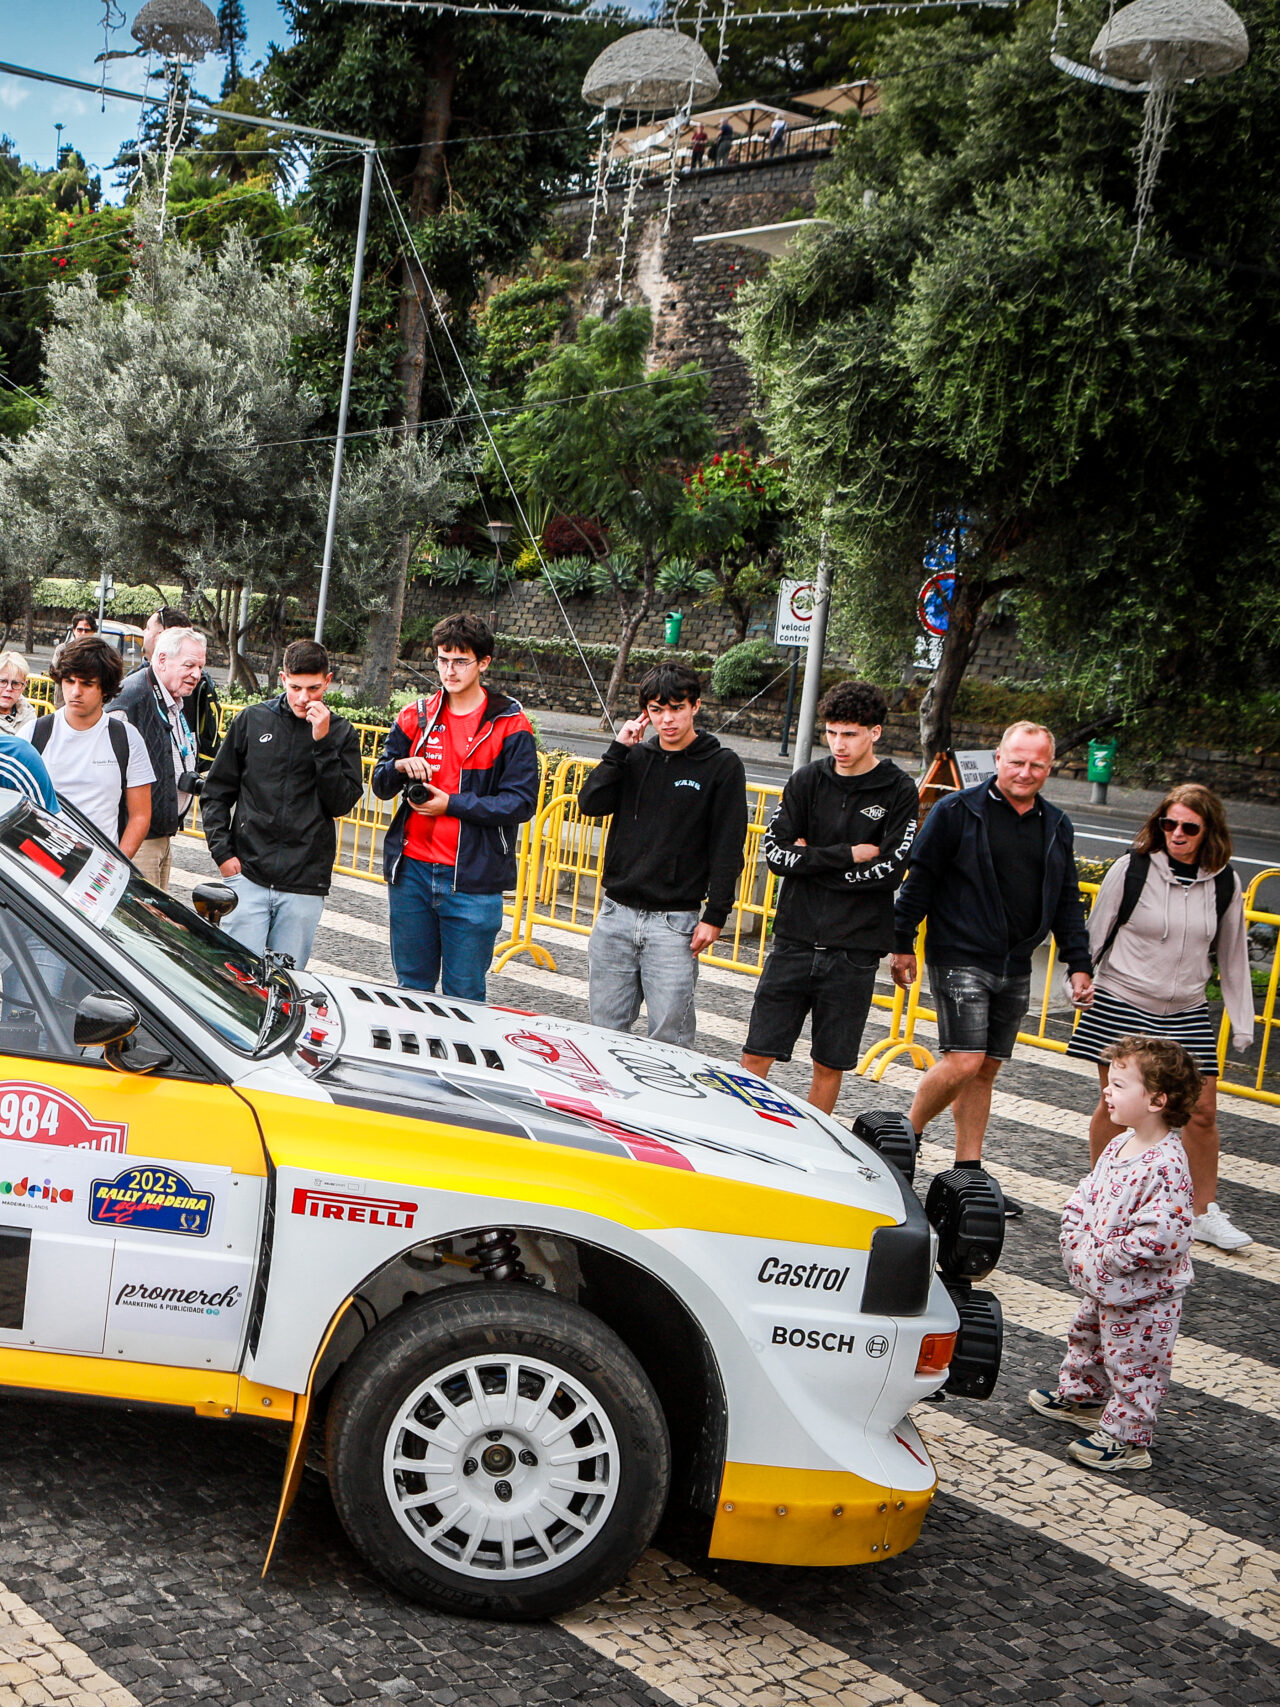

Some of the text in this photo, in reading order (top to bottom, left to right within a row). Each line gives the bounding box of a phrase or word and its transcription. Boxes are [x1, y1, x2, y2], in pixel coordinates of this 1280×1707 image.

[781, 623, 811, 632] velocid
[673, 779, 701, 791] VANS
[128, 1171, 178, 1193] 2025
[95, 1186, 208, 1211] RALLY MADEIRA
[291, 1187, 419, 1229] PIRELLI
[757, 1256, 851, 1292] Castrol
[115, 1283, 239, 1308] promerch
[122, 1299, 158, 1309] MARKETING
[165, 1304, 205, 1315] PUBLICIDADE
[771, 1325, 856, 1354] BOSCH
